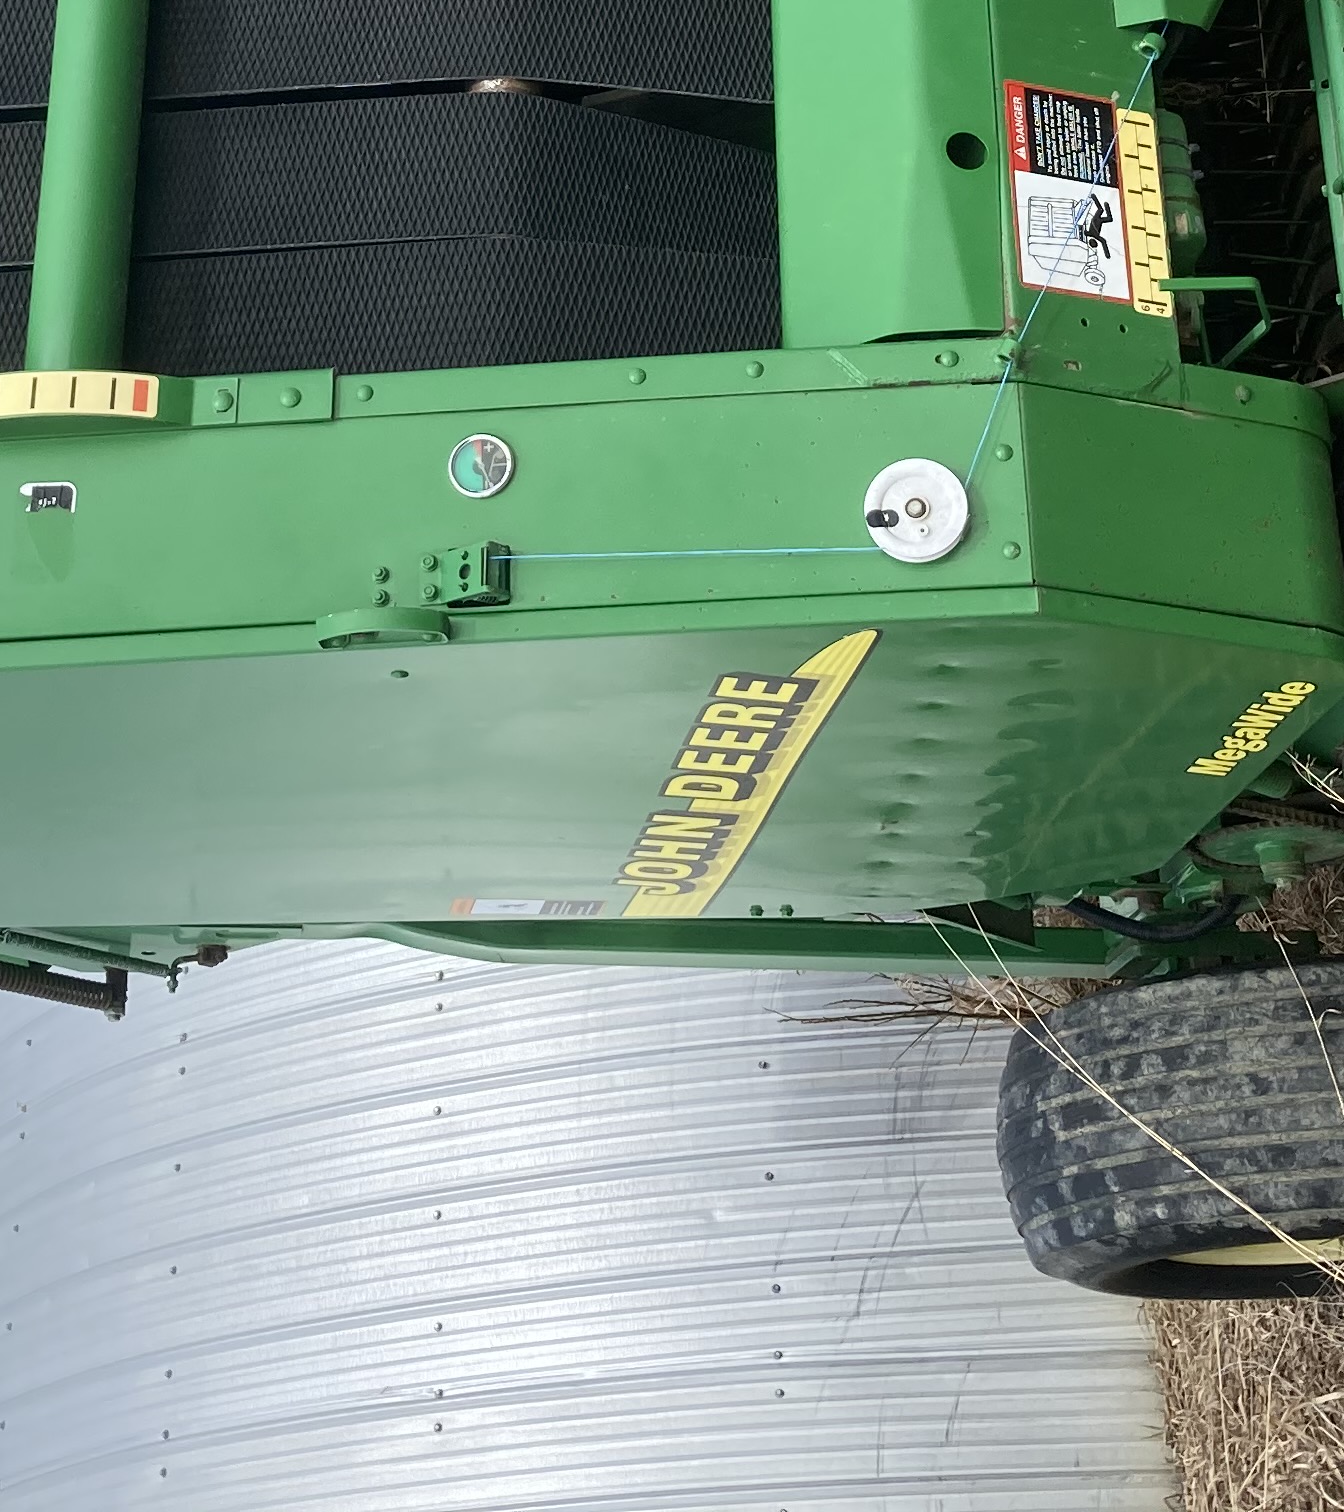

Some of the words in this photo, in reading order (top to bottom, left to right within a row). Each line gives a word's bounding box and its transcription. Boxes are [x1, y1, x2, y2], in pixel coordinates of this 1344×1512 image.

[1013, 96, 1025, 144] DANGER
[661, 673, 808, 801] DEERE
[1185, 681, 1316, 777] MegaWide
[615, 811, 729, 896] JOHN
